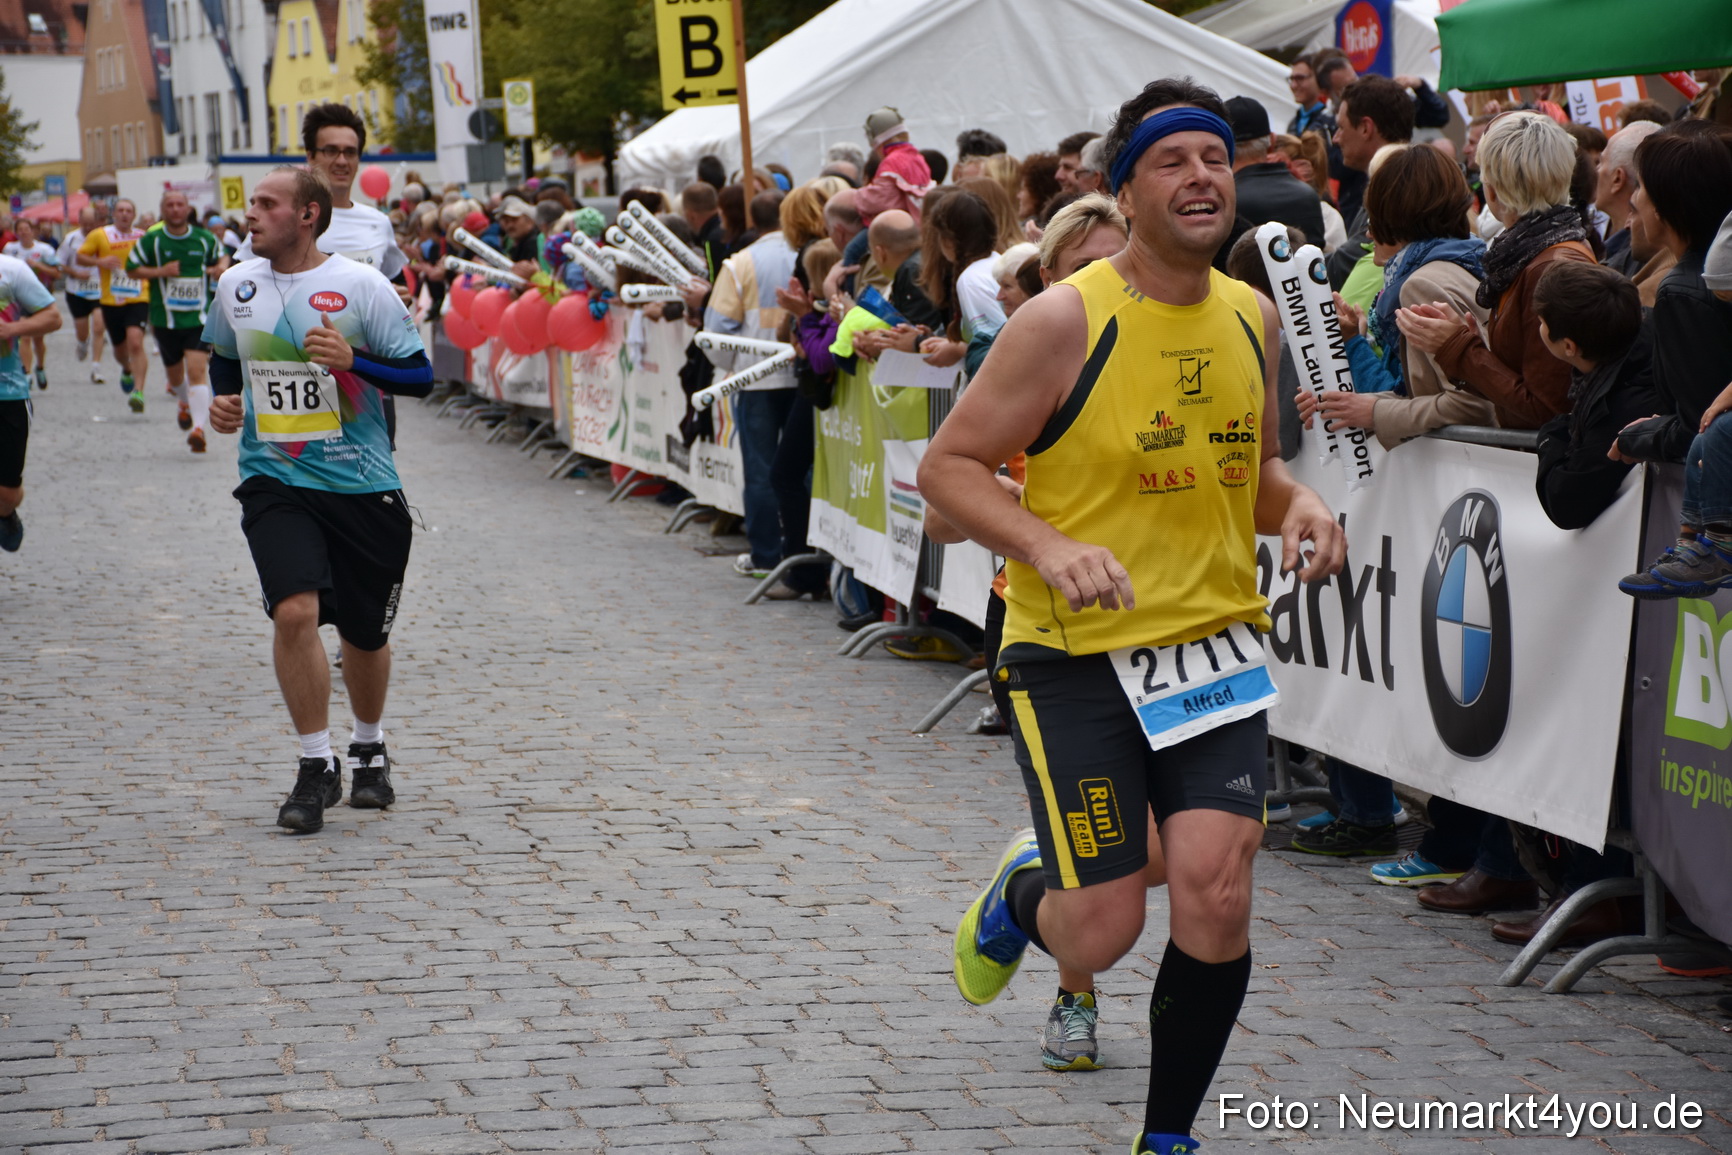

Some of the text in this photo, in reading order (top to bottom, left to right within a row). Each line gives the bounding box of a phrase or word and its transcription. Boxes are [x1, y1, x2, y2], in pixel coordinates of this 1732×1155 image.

[679, 14, 723, 77] B
[313, 294, 344, 309] Hervis
[1281, 276, 1312, 337] BMW
[719, 341, 751, 354] BMW
[252, 368, 318, 378] PARTL Neumarkt
[719, 358, 791, 397] BMW Laufsp
[1320, 300, 1374, 480] BMW Laport
[267, 380, 321, 411] 518
[1138, 466, 1196, 488] M & S
[1223, 466, 1249, 480] ELIO
[1434, 498, 1504, 588] BMW
[1130, 627, 1249, 695] 2711
[1136, 684, 1236, 716] B Alfred
[1225, 781, 1256, 796] adidas
[1088, 785, 1119, 839] Run!
[1069, 816, 1084, 855] Neumarkt
[1074, 814, 1094, 854] Team
